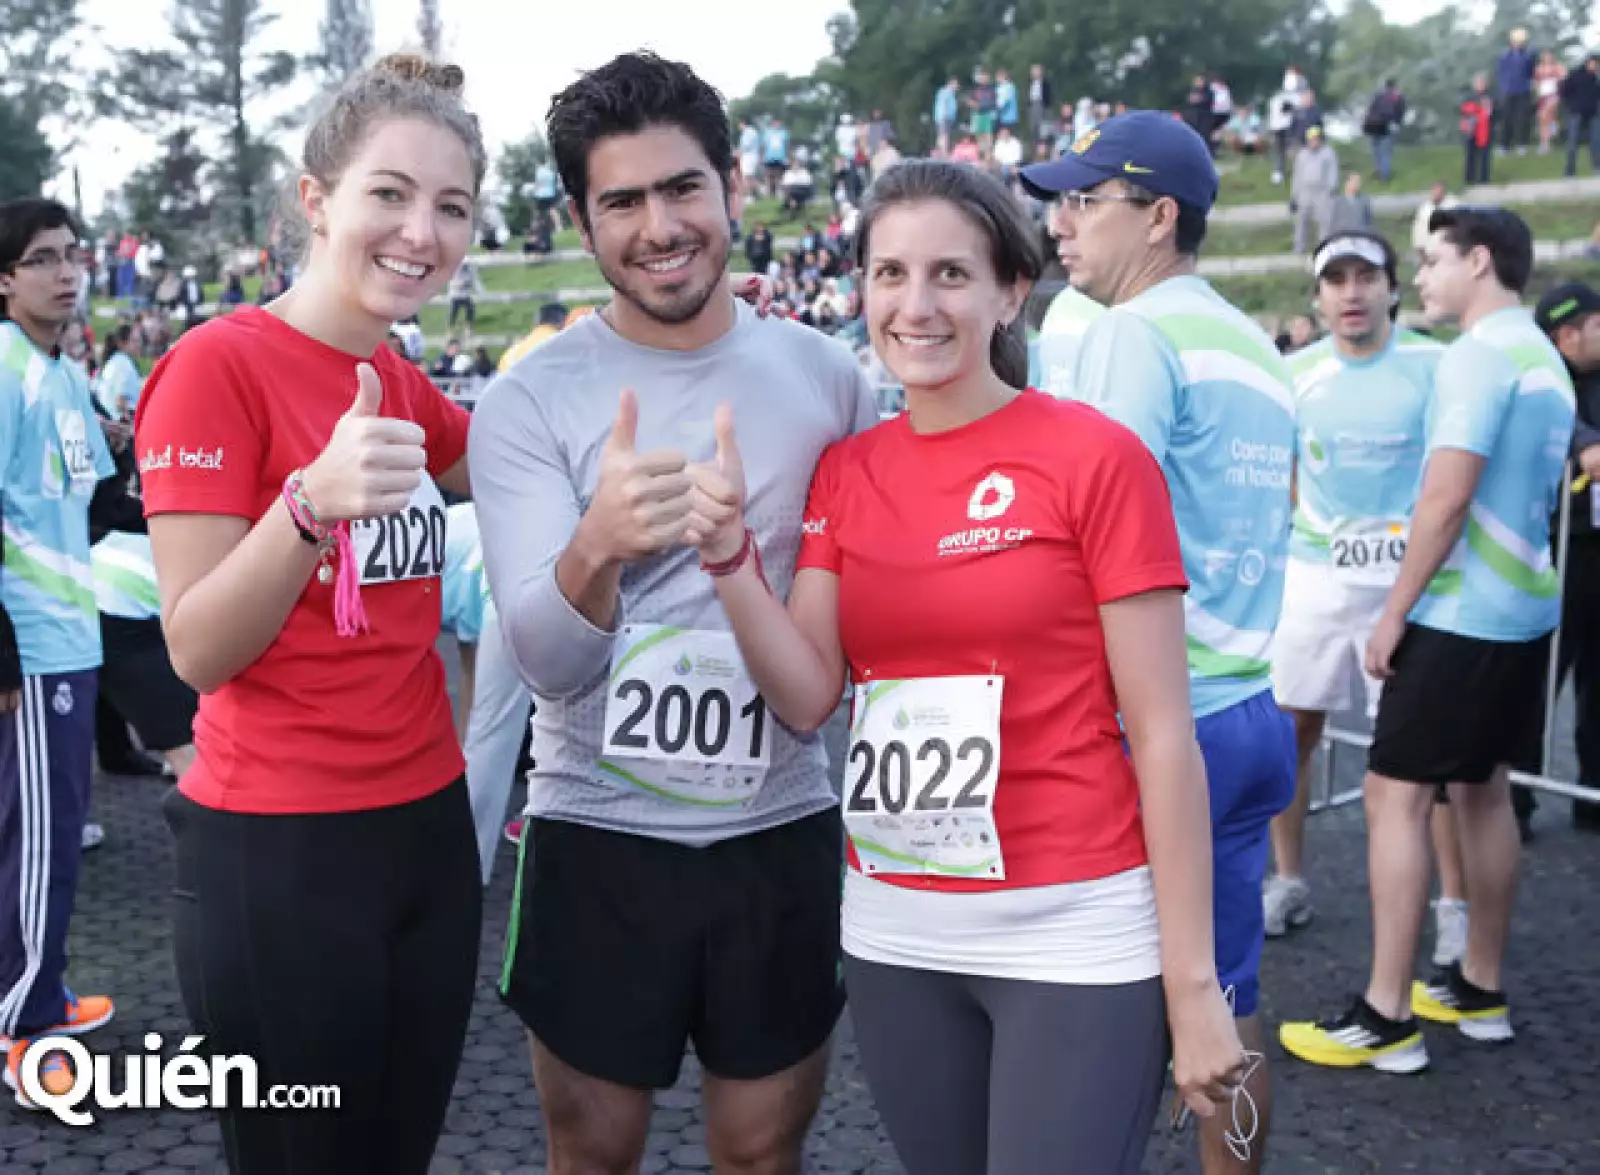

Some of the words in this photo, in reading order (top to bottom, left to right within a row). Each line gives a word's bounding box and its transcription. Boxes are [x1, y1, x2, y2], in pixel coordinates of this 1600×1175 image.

[178, 446, 224, 470] total
[363, 504, 446, 578] 2020
[609, 678, 767, 759] 2001
[847, 736, 994, 814] 2022
